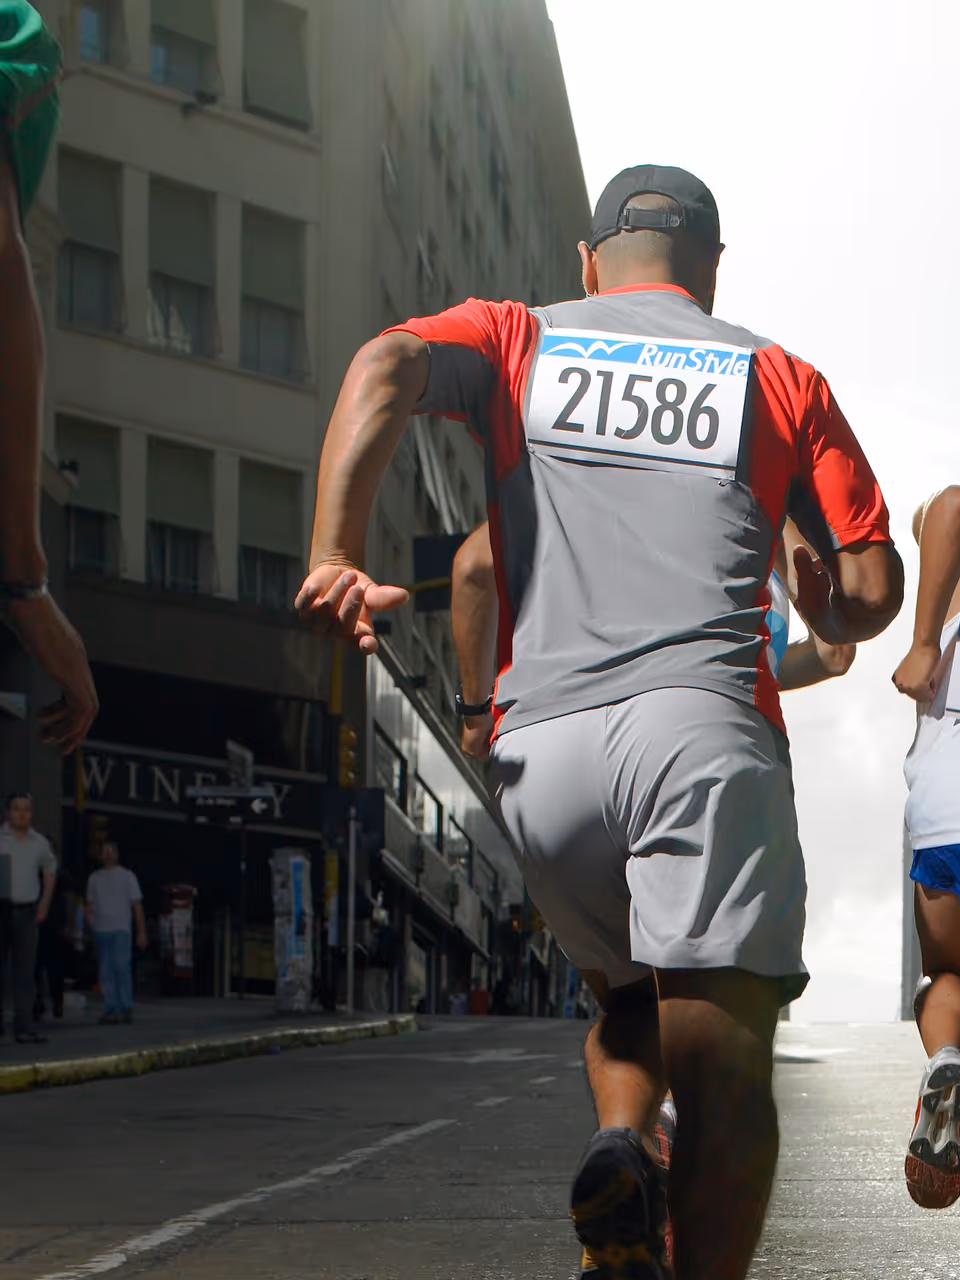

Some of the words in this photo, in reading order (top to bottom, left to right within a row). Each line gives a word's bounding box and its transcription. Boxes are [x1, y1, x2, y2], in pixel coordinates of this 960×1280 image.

[635, 343, 748, 376] RunStyle
[551, 366, 720, 450] 21586
[82, 754, 292, 818] WINY
